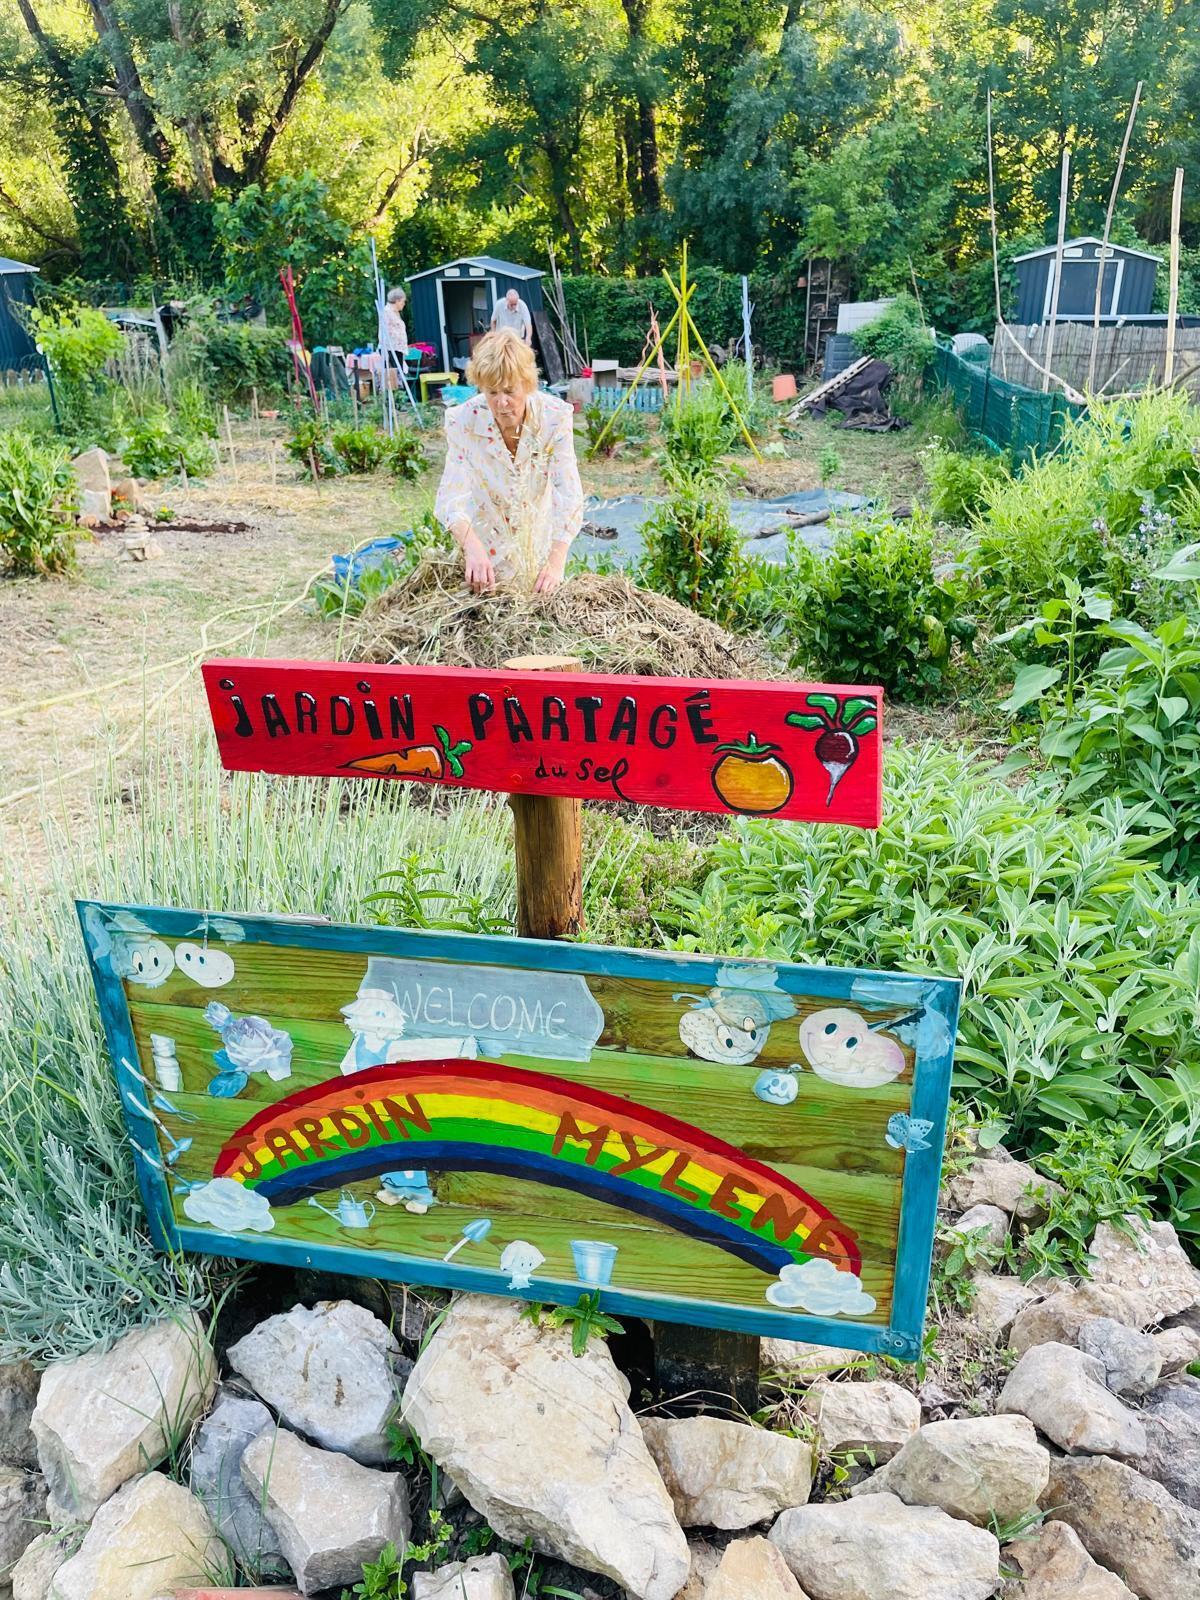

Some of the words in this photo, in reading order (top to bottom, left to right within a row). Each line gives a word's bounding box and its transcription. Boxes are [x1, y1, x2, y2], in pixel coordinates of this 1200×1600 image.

[468, 690, 719, 749] PARTAGÉ
[535, 756, 567, 779] du
[391, 981, 569, 1039] WELCOME
[551, 1111, 859, 1265] MYLENE
